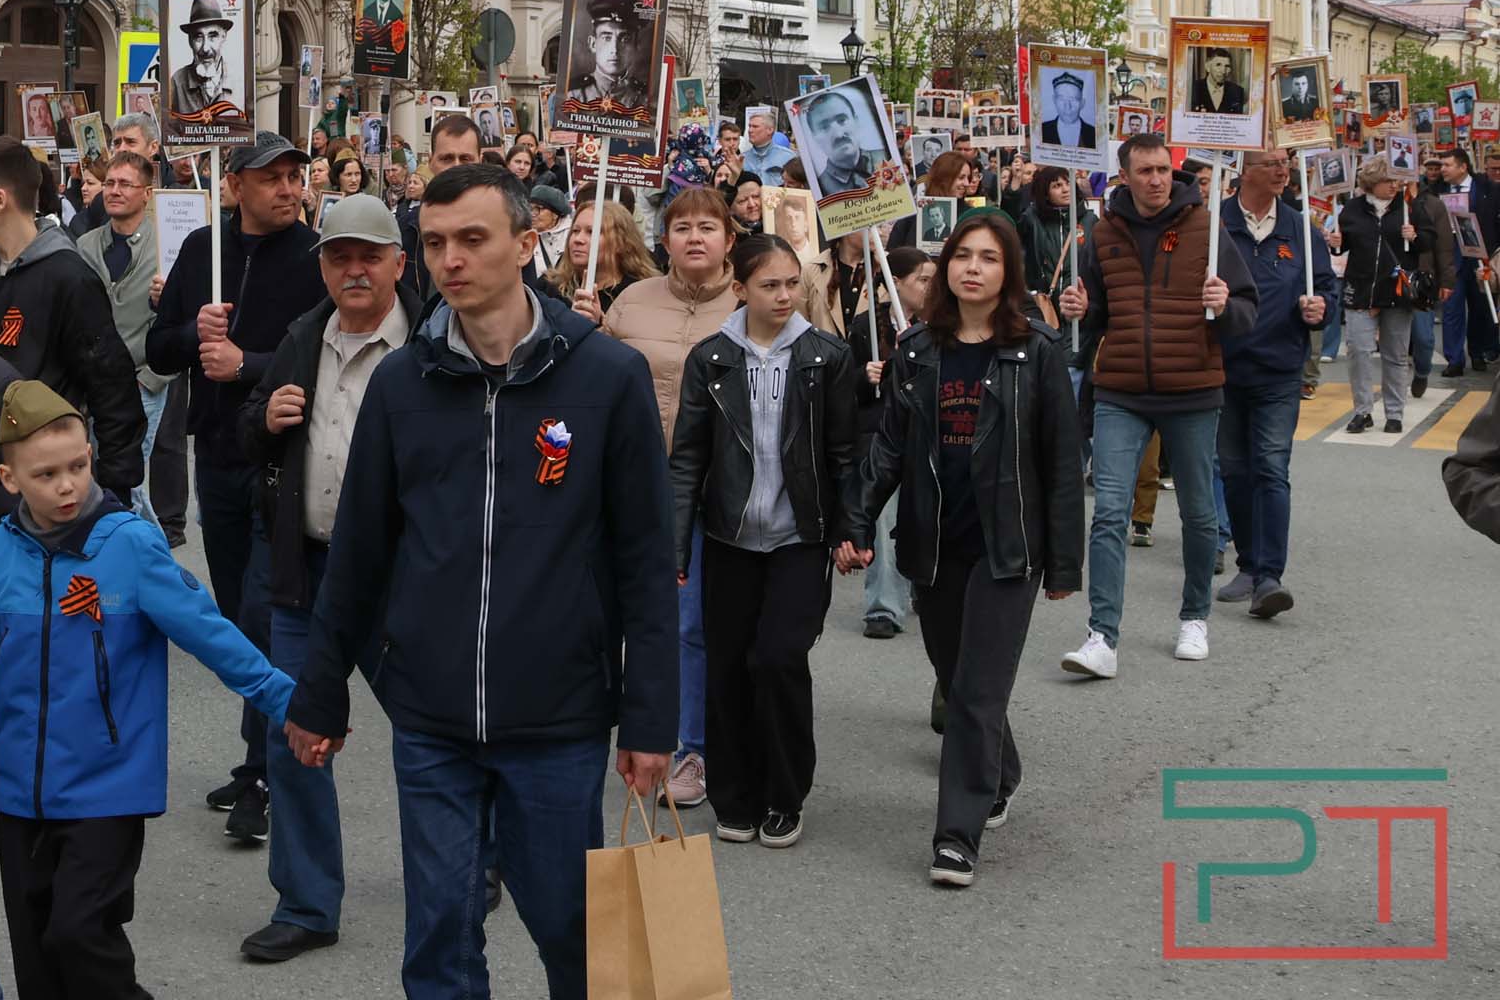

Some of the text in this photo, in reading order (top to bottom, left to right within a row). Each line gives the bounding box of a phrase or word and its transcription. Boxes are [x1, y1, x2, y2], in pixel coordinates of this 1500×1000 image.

[570, 113, 639, 129] ГИМАЛТДИНОВ
[184, 126, 230, 134] ШАГАЛИЕВ
[592, 125, 651, 138] Гималтдинович
[167, 135, 248, 144] Мирзагали Шагалиевич
[844, 193, 880, 210] Юсупов
[827, 211, 863, 226] Ибрагим
